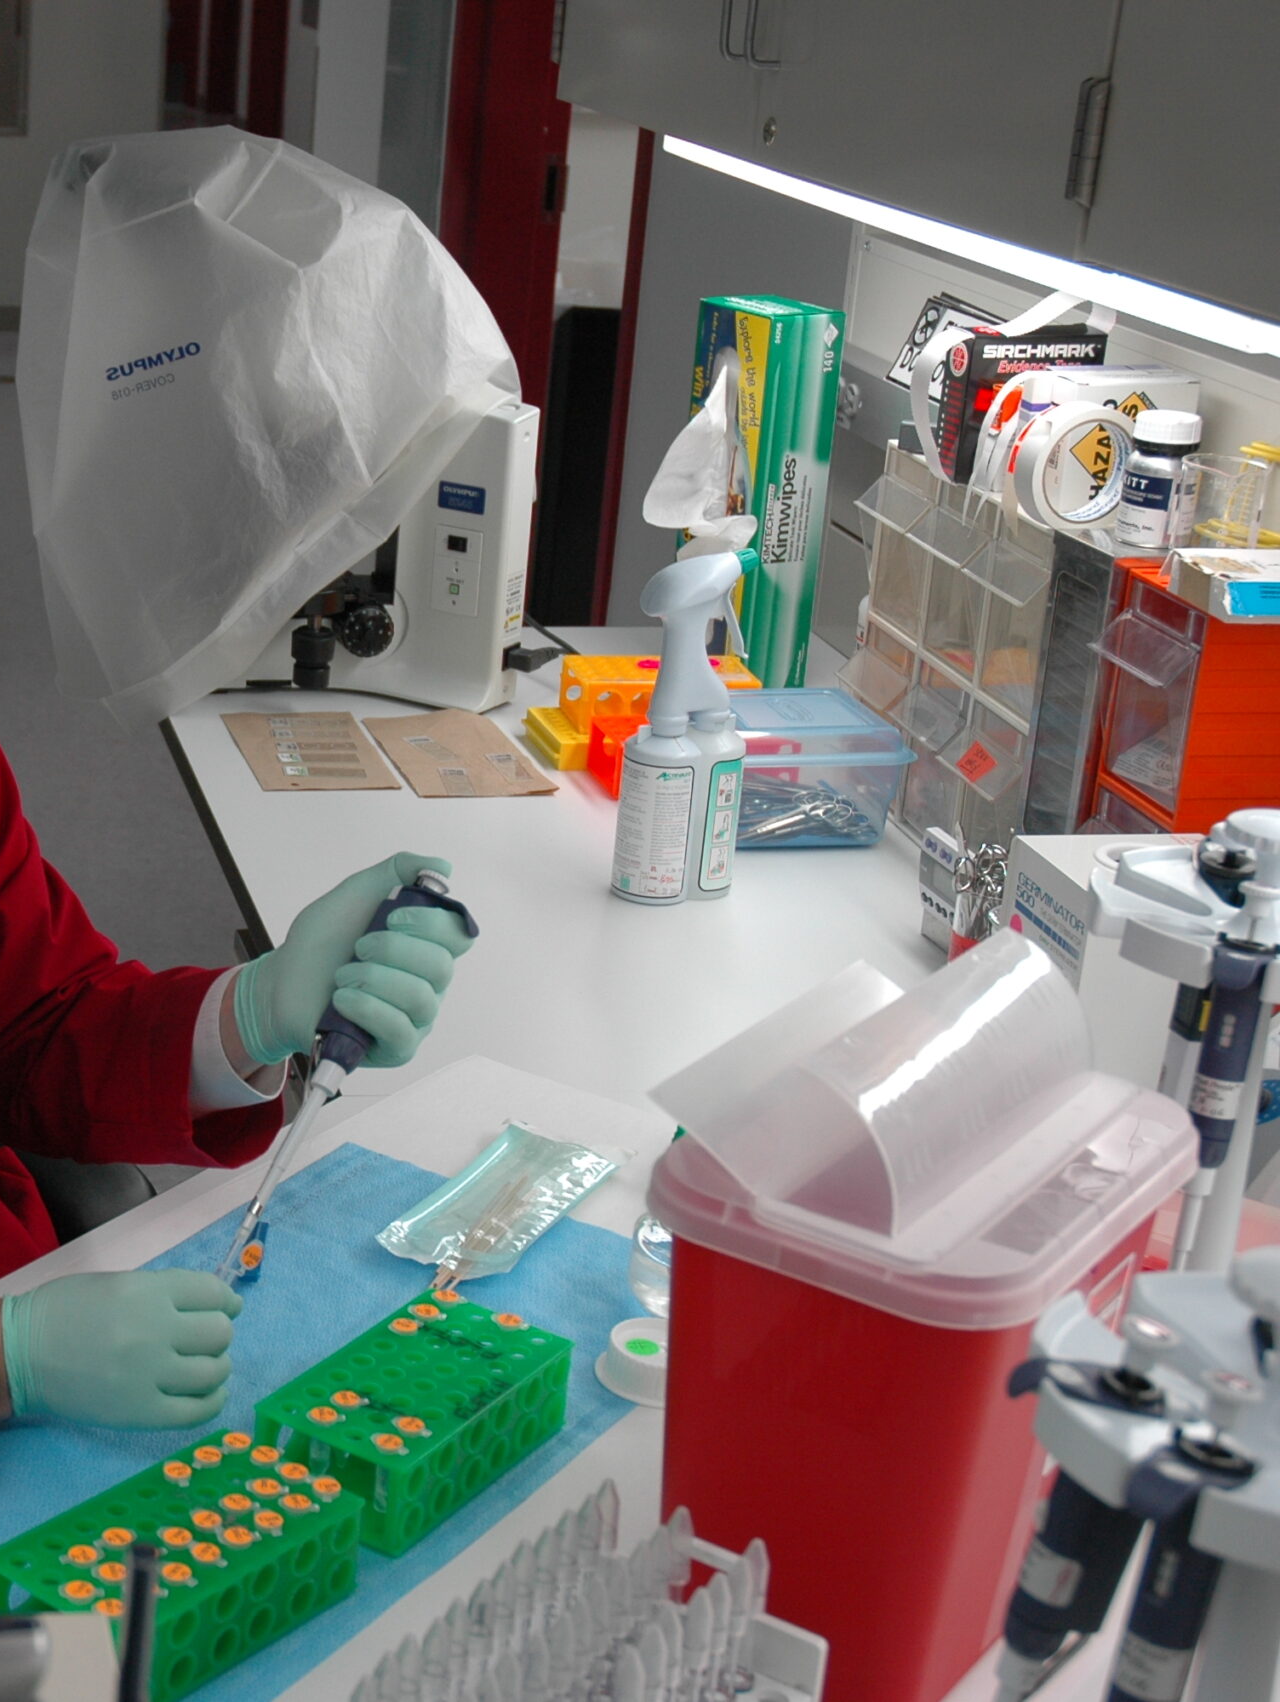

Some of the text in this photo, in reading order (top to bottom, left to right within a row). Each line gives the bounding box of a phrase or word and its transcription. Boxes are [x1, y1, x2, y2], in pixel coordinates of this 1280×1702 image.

[739, 316, 759, 427] Explore the world
[823, 351, 834, 373] 140
[982, 344, 1095, 359] SIRCHMARK
[770, 457, 797, 564] Kimwipes
[762, 511, 775, 564] KIMTECH
[1015, 884, 1035, 908] 500
[1018, 872, 1085, 935] GERMINATOR
